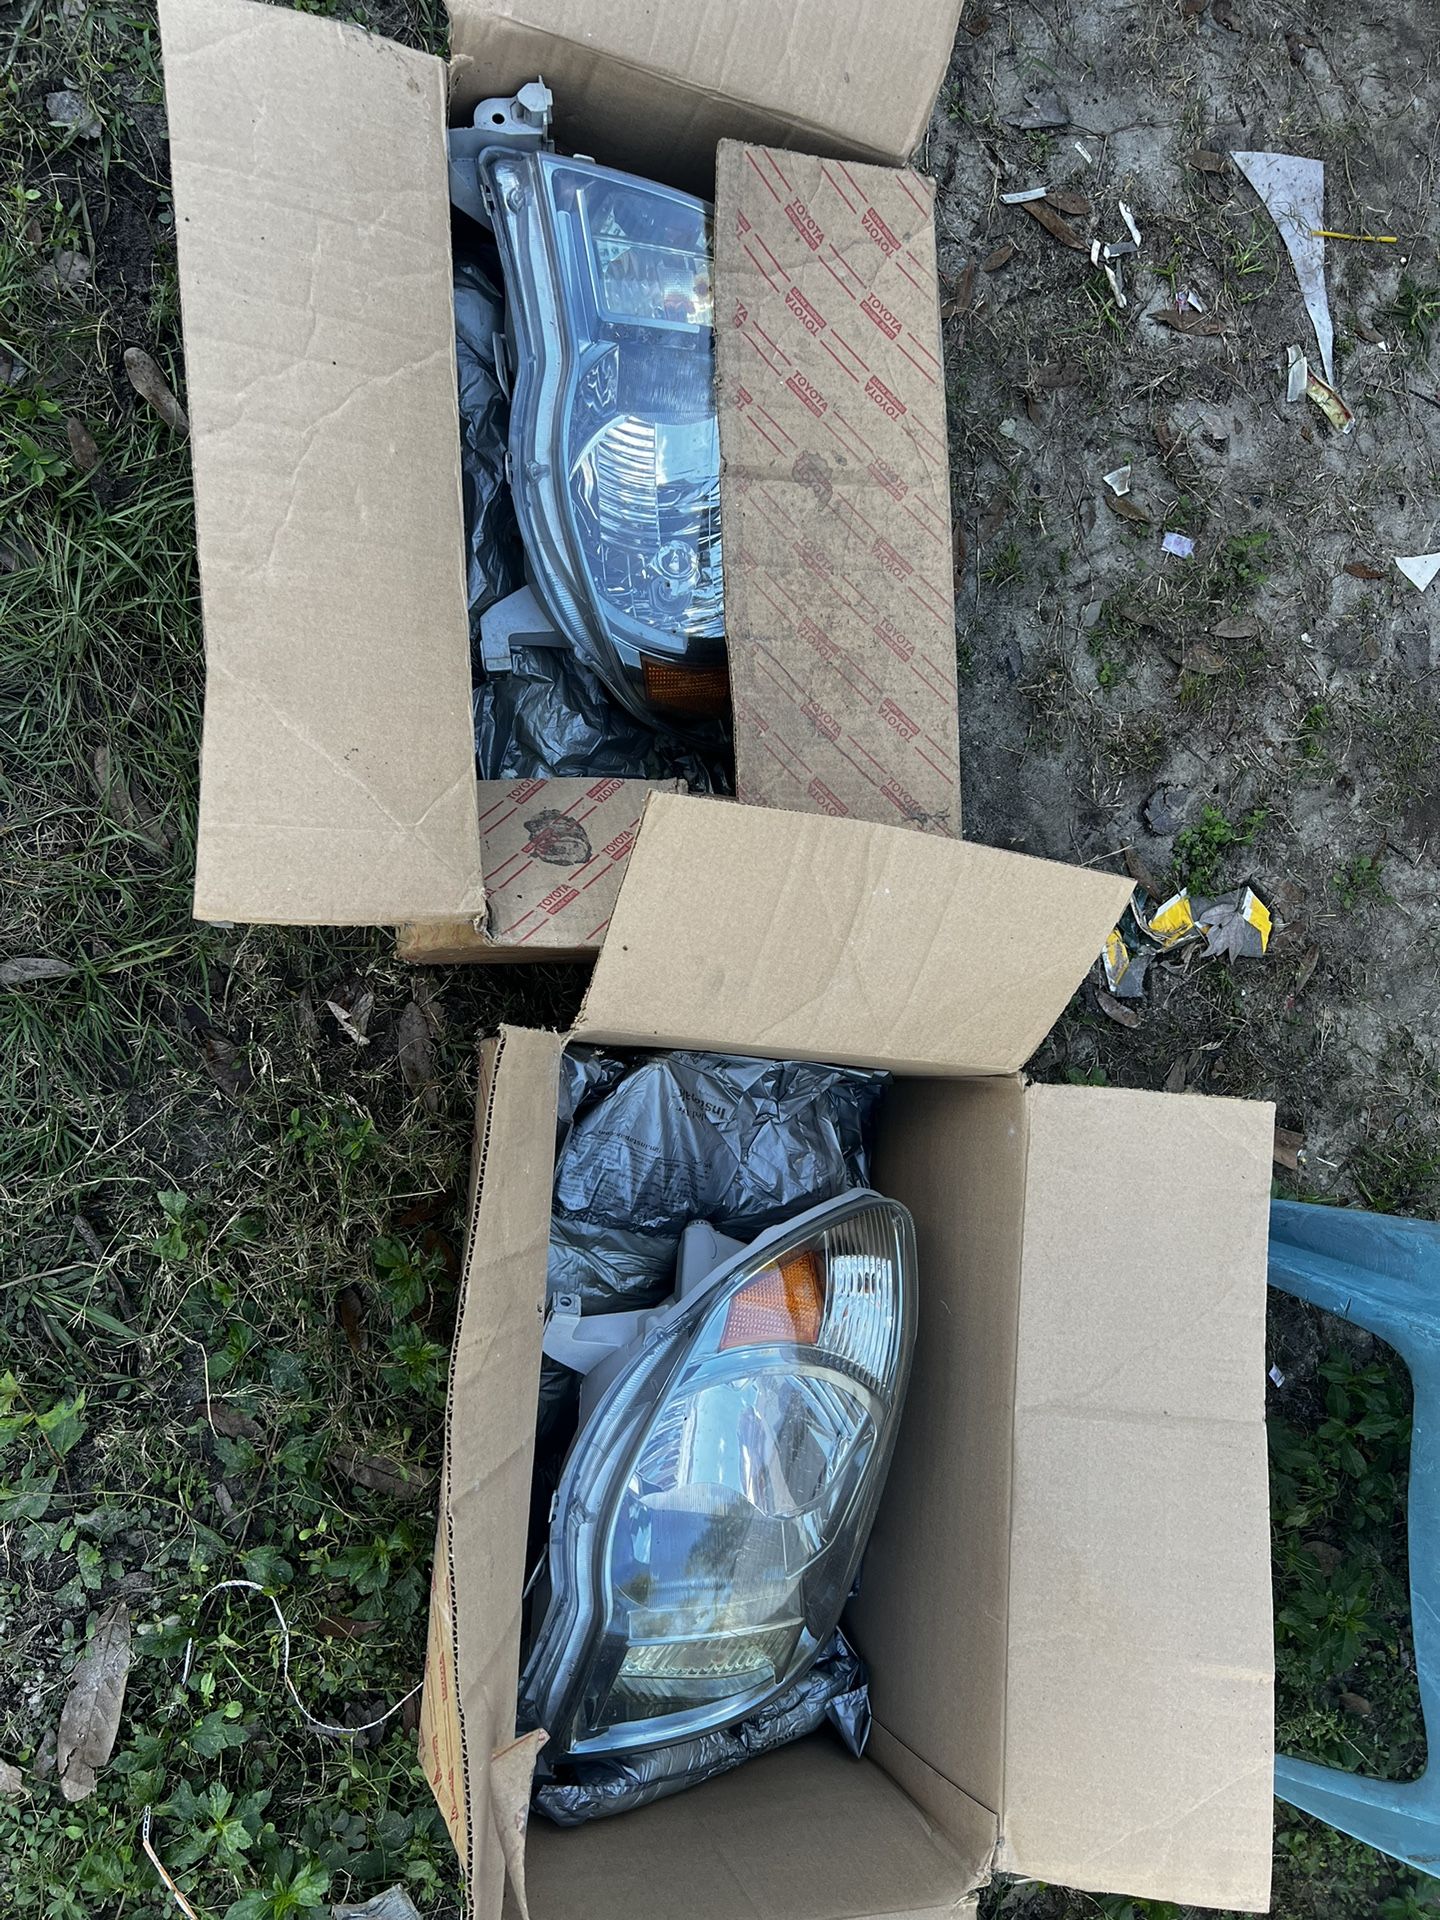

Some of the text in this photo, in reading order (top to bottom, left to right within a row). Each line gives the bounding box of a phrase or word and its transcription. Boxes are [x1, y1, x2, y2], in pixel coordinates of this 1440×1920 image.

[791, 198, 827, 243] TOYOTA
[860, 215, 895, 257] TOYOTA
[784, 294, 820, 336] TOYOTA
[867, 293, 903, 332] TOYOTA
[792, 371, 829, 411] TOYOTA
[863, 383, 901, 421] TOYOTA
[874, 458, 910, 494] TOYOTA
[799, 536, 835, 572] TOYOTA
[871, 546, 907, 582] TOYOTA
[797, 625, 833, 661] TOYOTA
[880, 618, 917, 655] TOYOTA
[807, 699, 844, 735] TOYOTA
[876, 706, 913, 742] TOYOTA
[507, 779, 533, 798] TOYOT
[595, 781, 624, 802] TOYOTA
[806, 784, 840, 816] OYOTA
[602, 831, 632, 854] TOYOTA
[537, 884, 571, 909] TOYOTA
